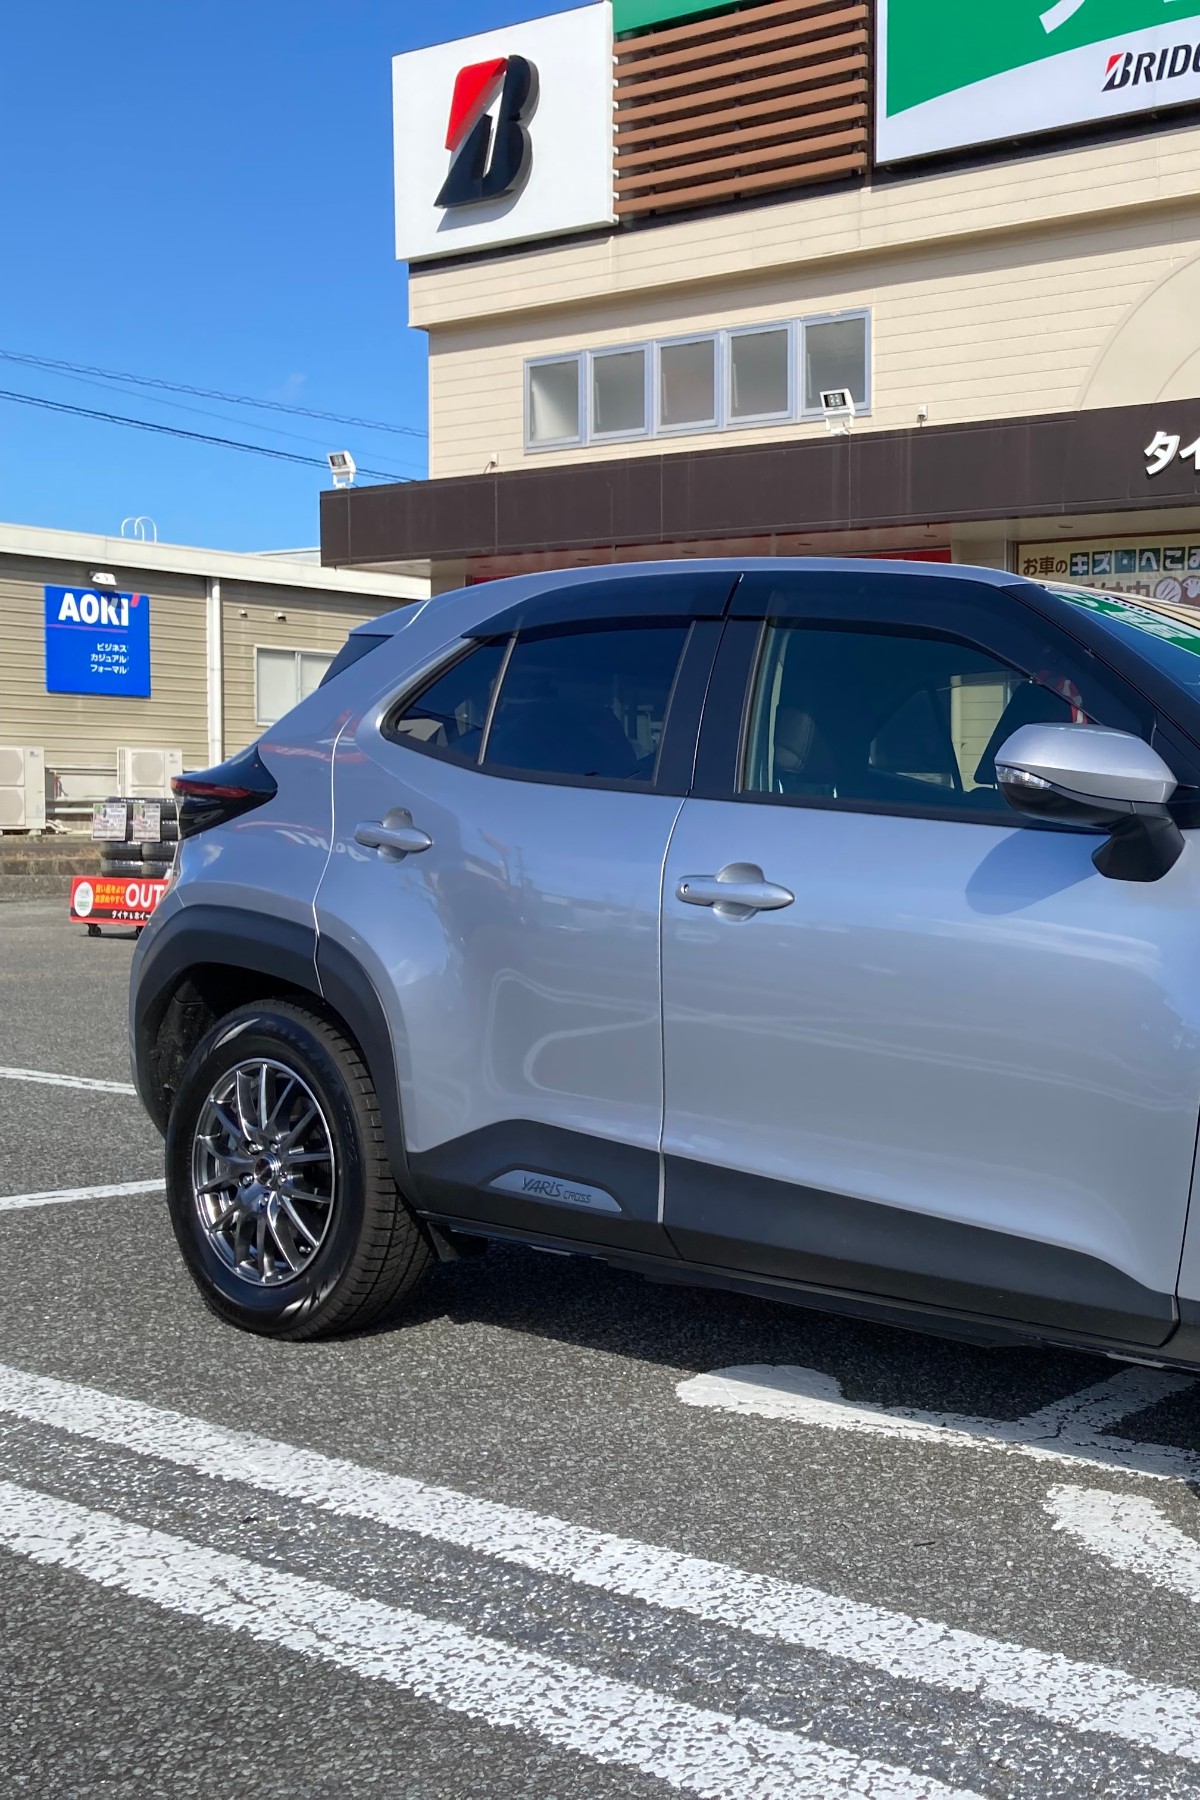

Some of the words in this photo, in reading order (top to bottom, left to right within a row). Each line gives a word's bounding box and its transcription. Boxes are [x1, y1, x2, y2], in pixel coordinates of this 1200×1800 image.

[58, 592, 129, 626] AOKI
[96, 643, 128, 653] ビジネス
[90, 653, 128, 664] カジュアル
[90, 664, 128, 675] フォーマル
[562, 1190, 592, 1204] CROSS
